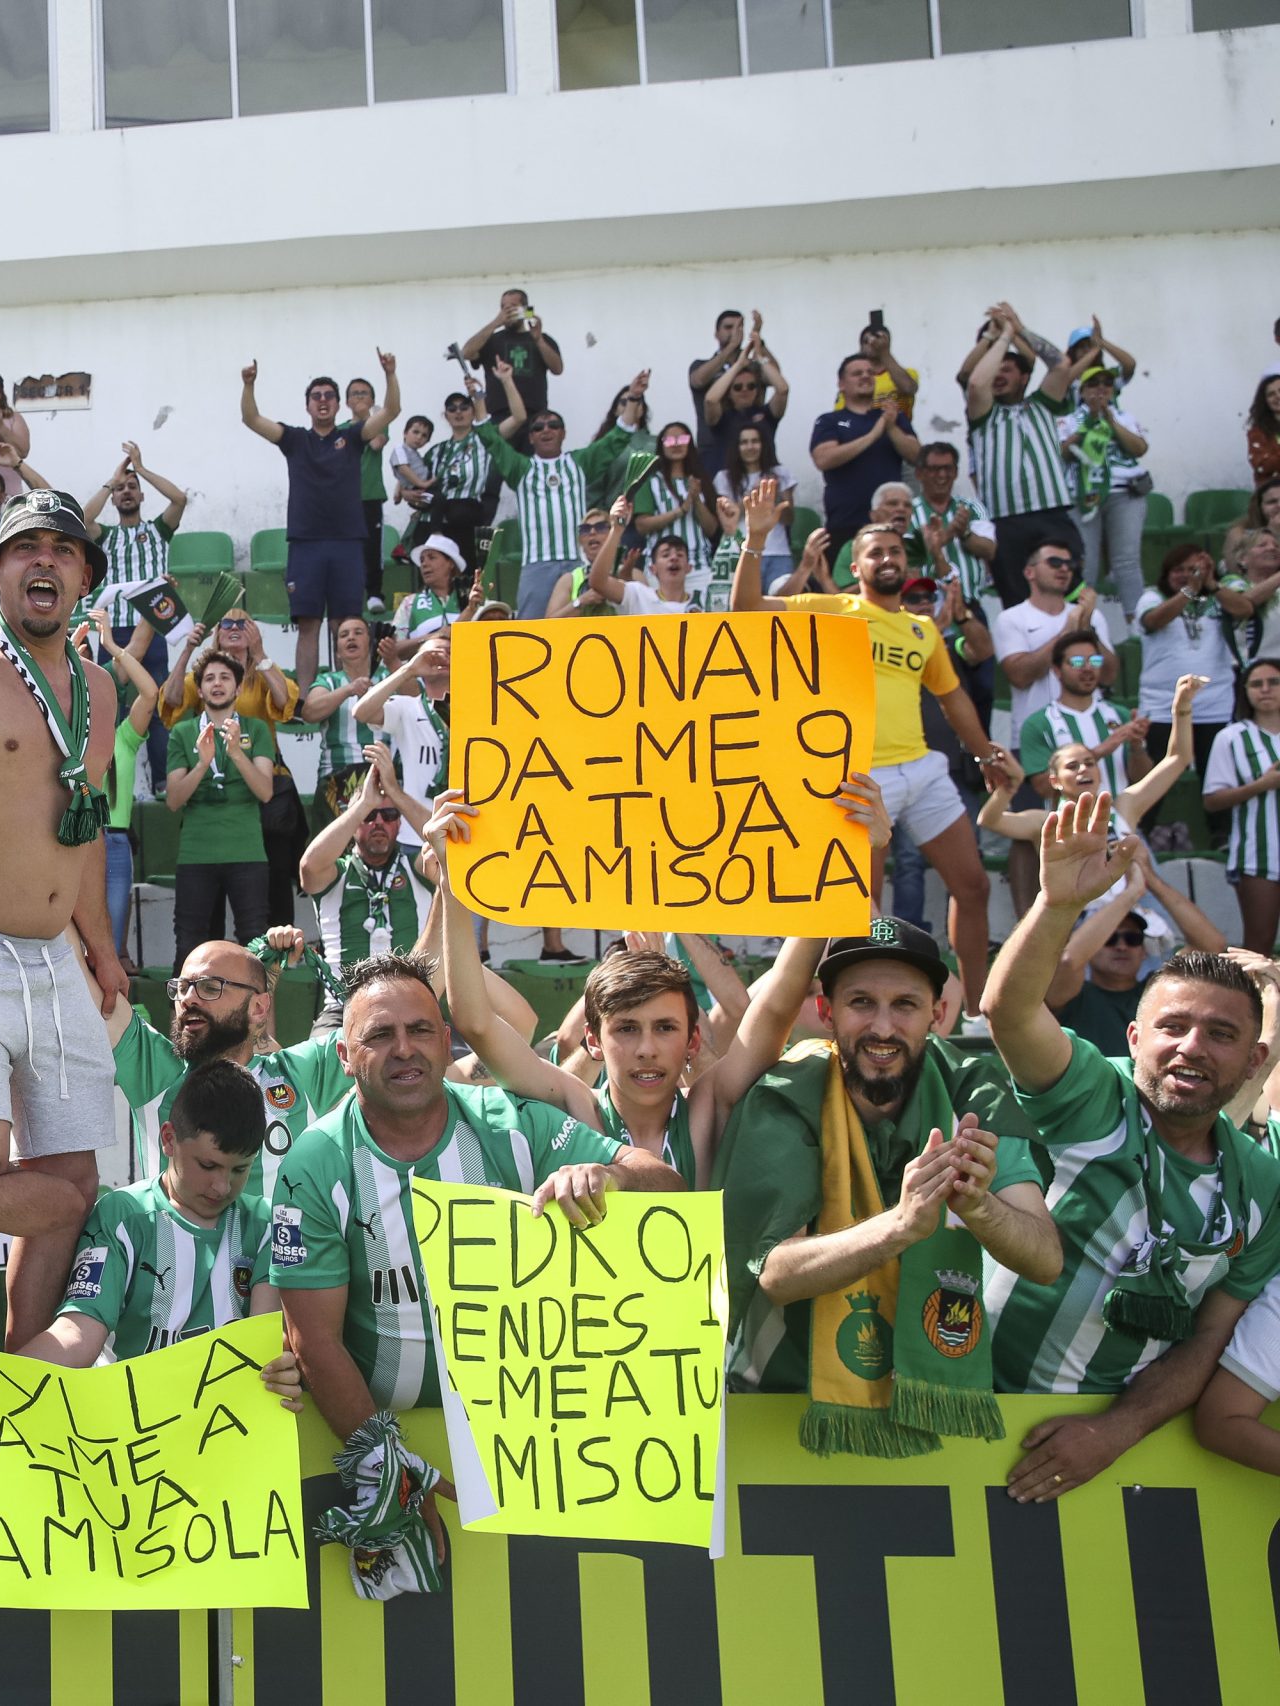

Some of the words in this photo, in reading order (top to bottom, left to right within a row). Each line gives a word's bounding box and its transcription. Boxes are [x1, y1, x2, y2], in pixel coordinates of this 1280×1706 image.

[490, 614, 821, 725] RONAN
[796, 709, 852, 798] 9
[515, 803, 554, 850] A
[587, 781, 800, 854] TUA
[271, 1242, 308, 1258] SABSEG
[434, 1293, 649, 1362] ENDES
[649, 1348, 720, 1416] TU
[198, 1403, 250, 1455] A
[28, 1462, 200, 1532] TUA
